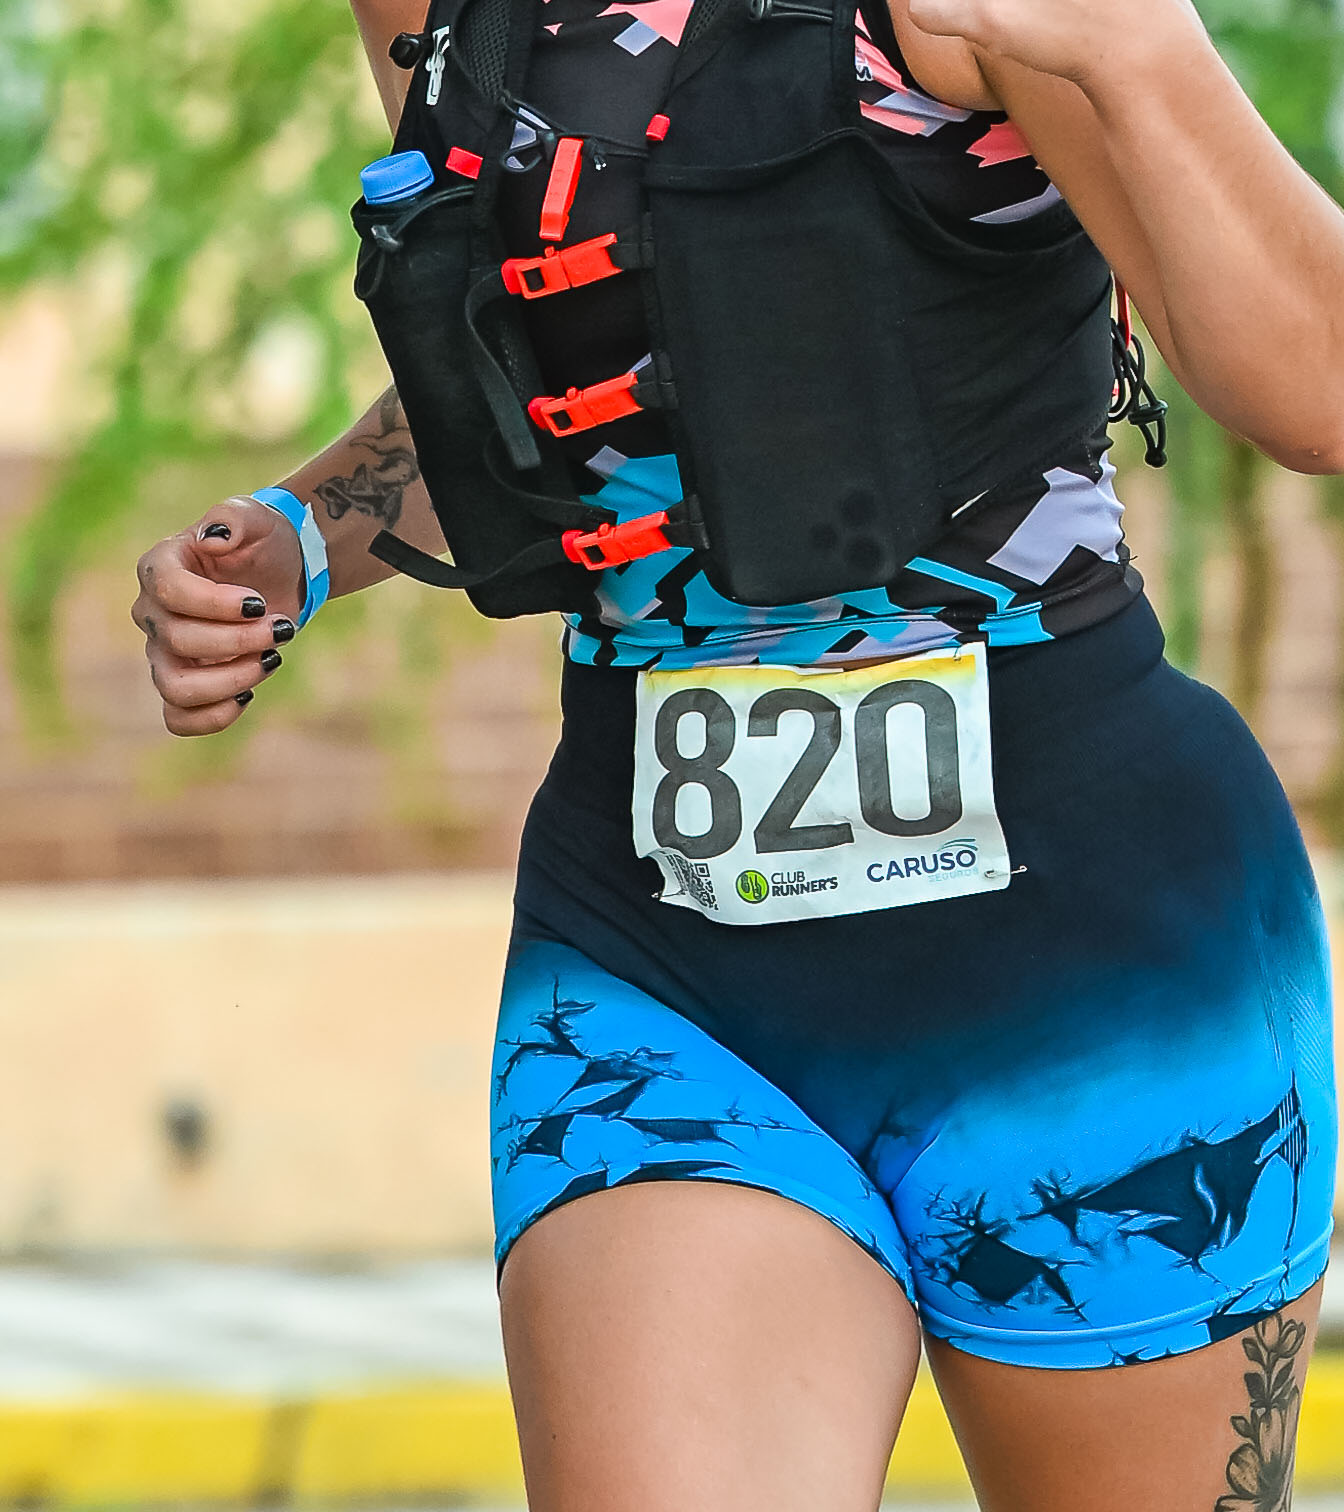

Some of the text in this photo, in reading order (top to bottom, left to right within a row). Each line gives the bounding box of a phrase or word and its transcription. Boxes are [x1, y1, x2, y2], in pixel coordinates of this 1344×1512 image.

[652, 679, 963, 859] 820
[771, 871, 805, 885] CLUB
[866, 849, 977, 883] CARUSO
[771, 877, 839, 897] RUNNER'S
